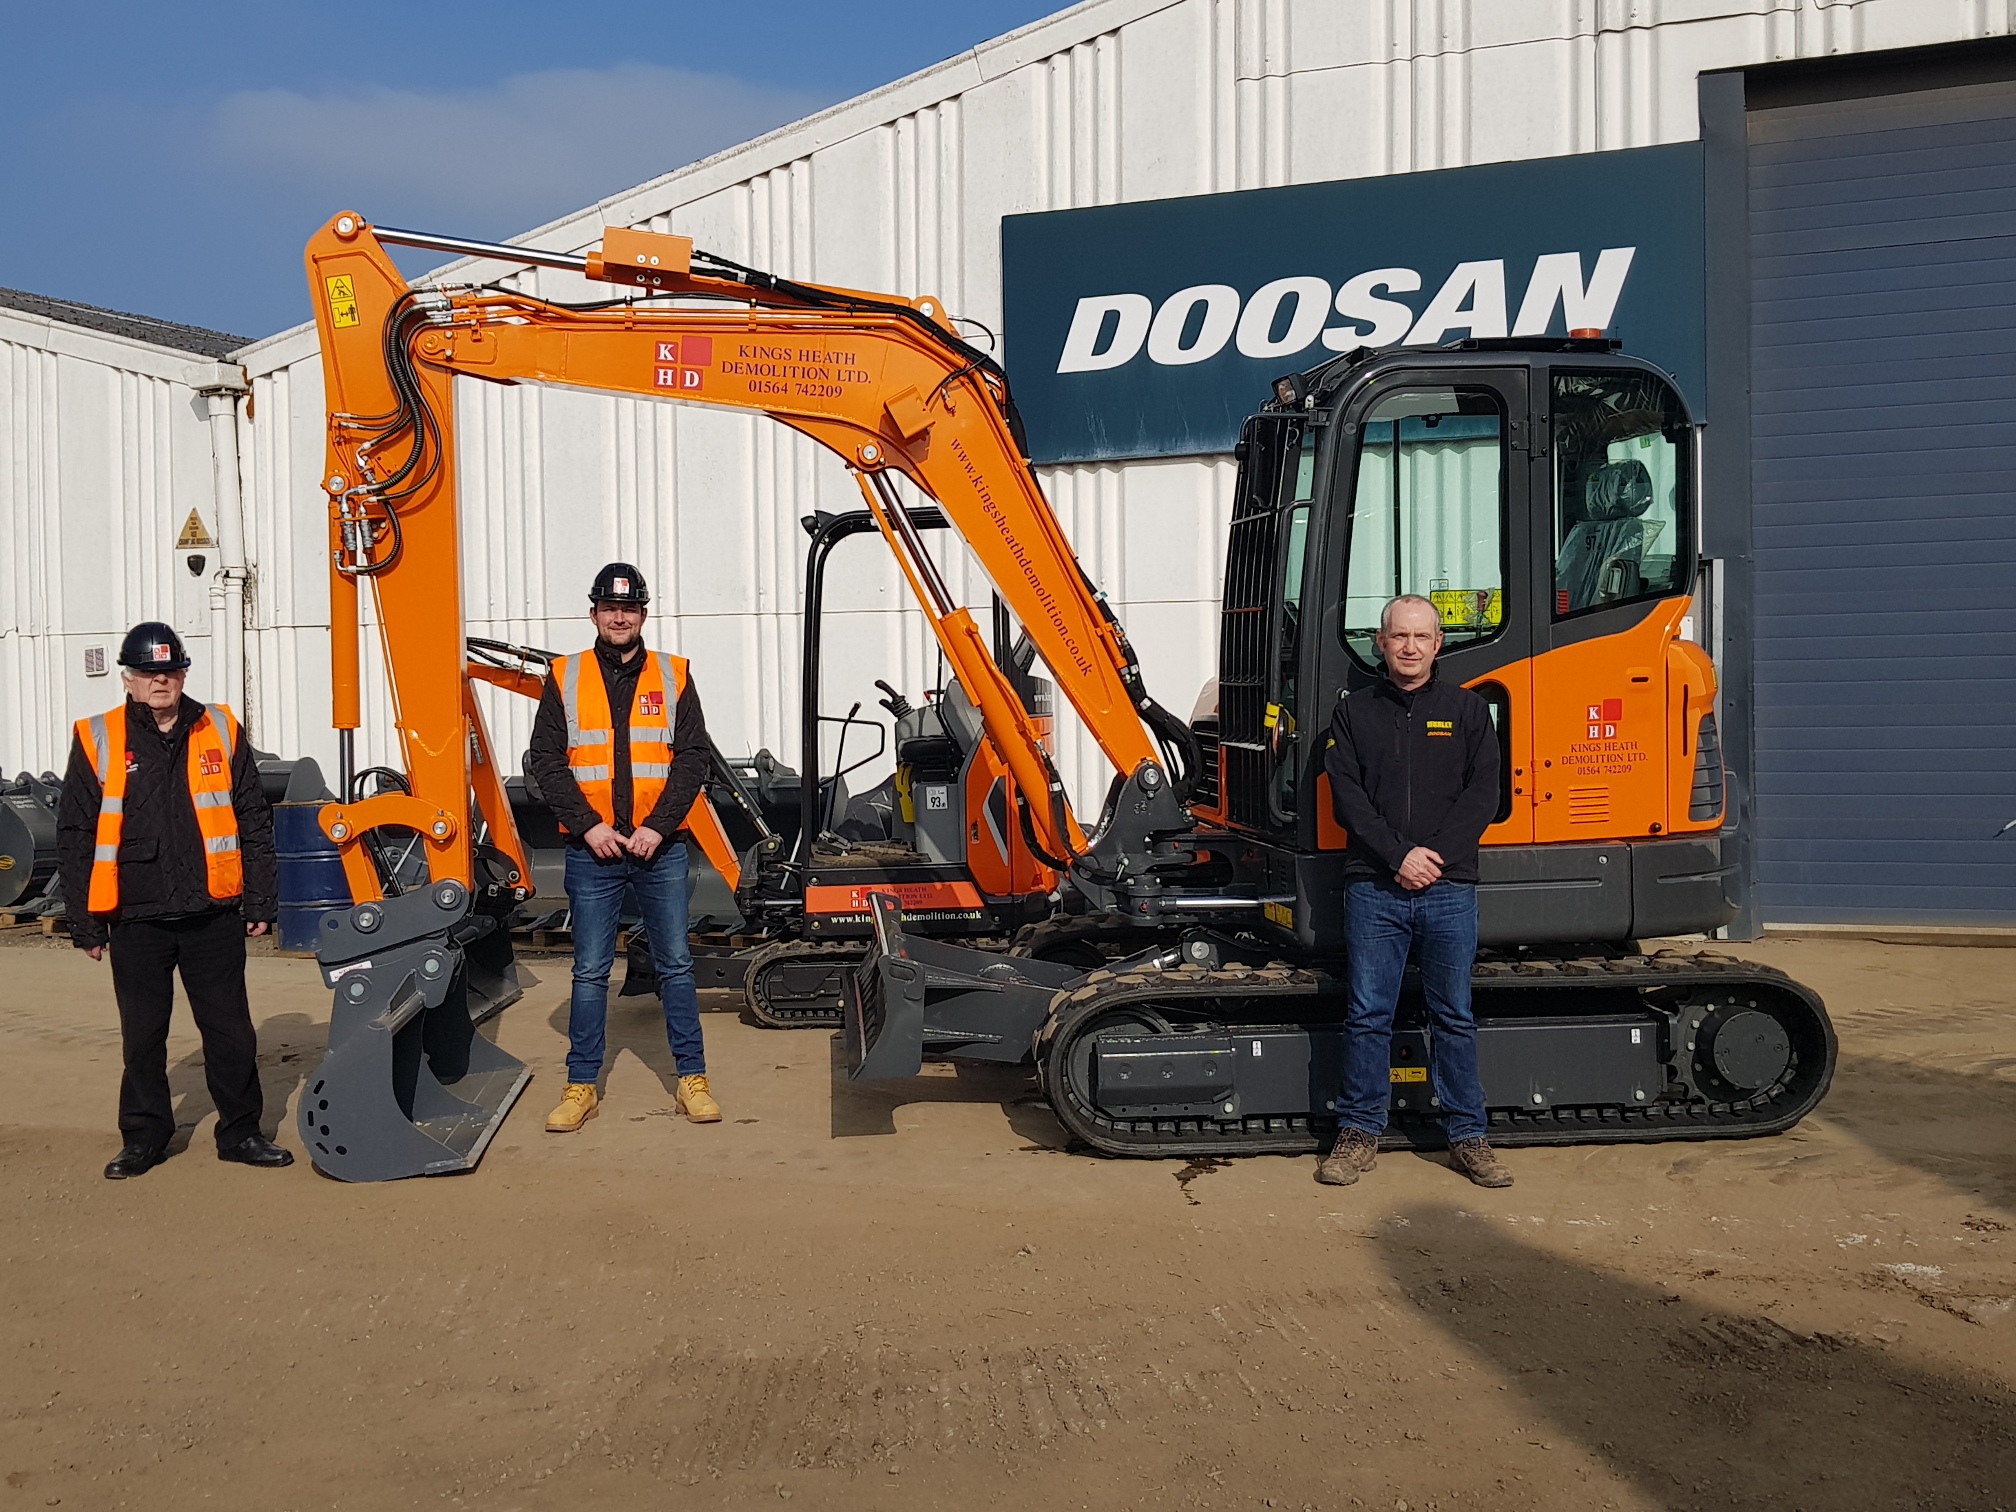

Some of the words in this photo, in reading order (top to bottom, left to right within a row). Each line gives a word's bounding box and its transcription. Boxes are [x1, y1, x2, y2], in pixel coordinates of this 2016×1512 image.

[1057, 247, 1636, 373] DOOSAN
[658, 343, 675, 361] K
[739, 344, 792, 361] KINGS
[799, 348, 856, 365] HEATH
[657, 368, 674, 386] H
[683, 370, 700, 387] D
[721, 361, 830, 381] DEMOLITION
[836, 368, 872, 384] LTD.
[748, 379, 788, 395] 01564
[795, 383, 843, 398] 742209
[1585, 535, 1596, 550] 97
[950, 438, 1093, 678] www.kingsheathdemolition.co.uk
[640, 695, 648, 703] K
[1588, 706, 1600, 720] K
[1588, 725, 1599, 739] H
[1604, 724, 1615, 738] D
[1570, 743, 1601, 753] KINGS
[1604, 741, 1638, 751] HEATH
[1561, 753, 1624, 765] DEMOLITION
[1627, 753, 1648, 762] LTD.
[1577, 766, 1600, 775] 01564
[1604, 764, 1632, 774] 742209
[930, 796, 941, 808] 93
